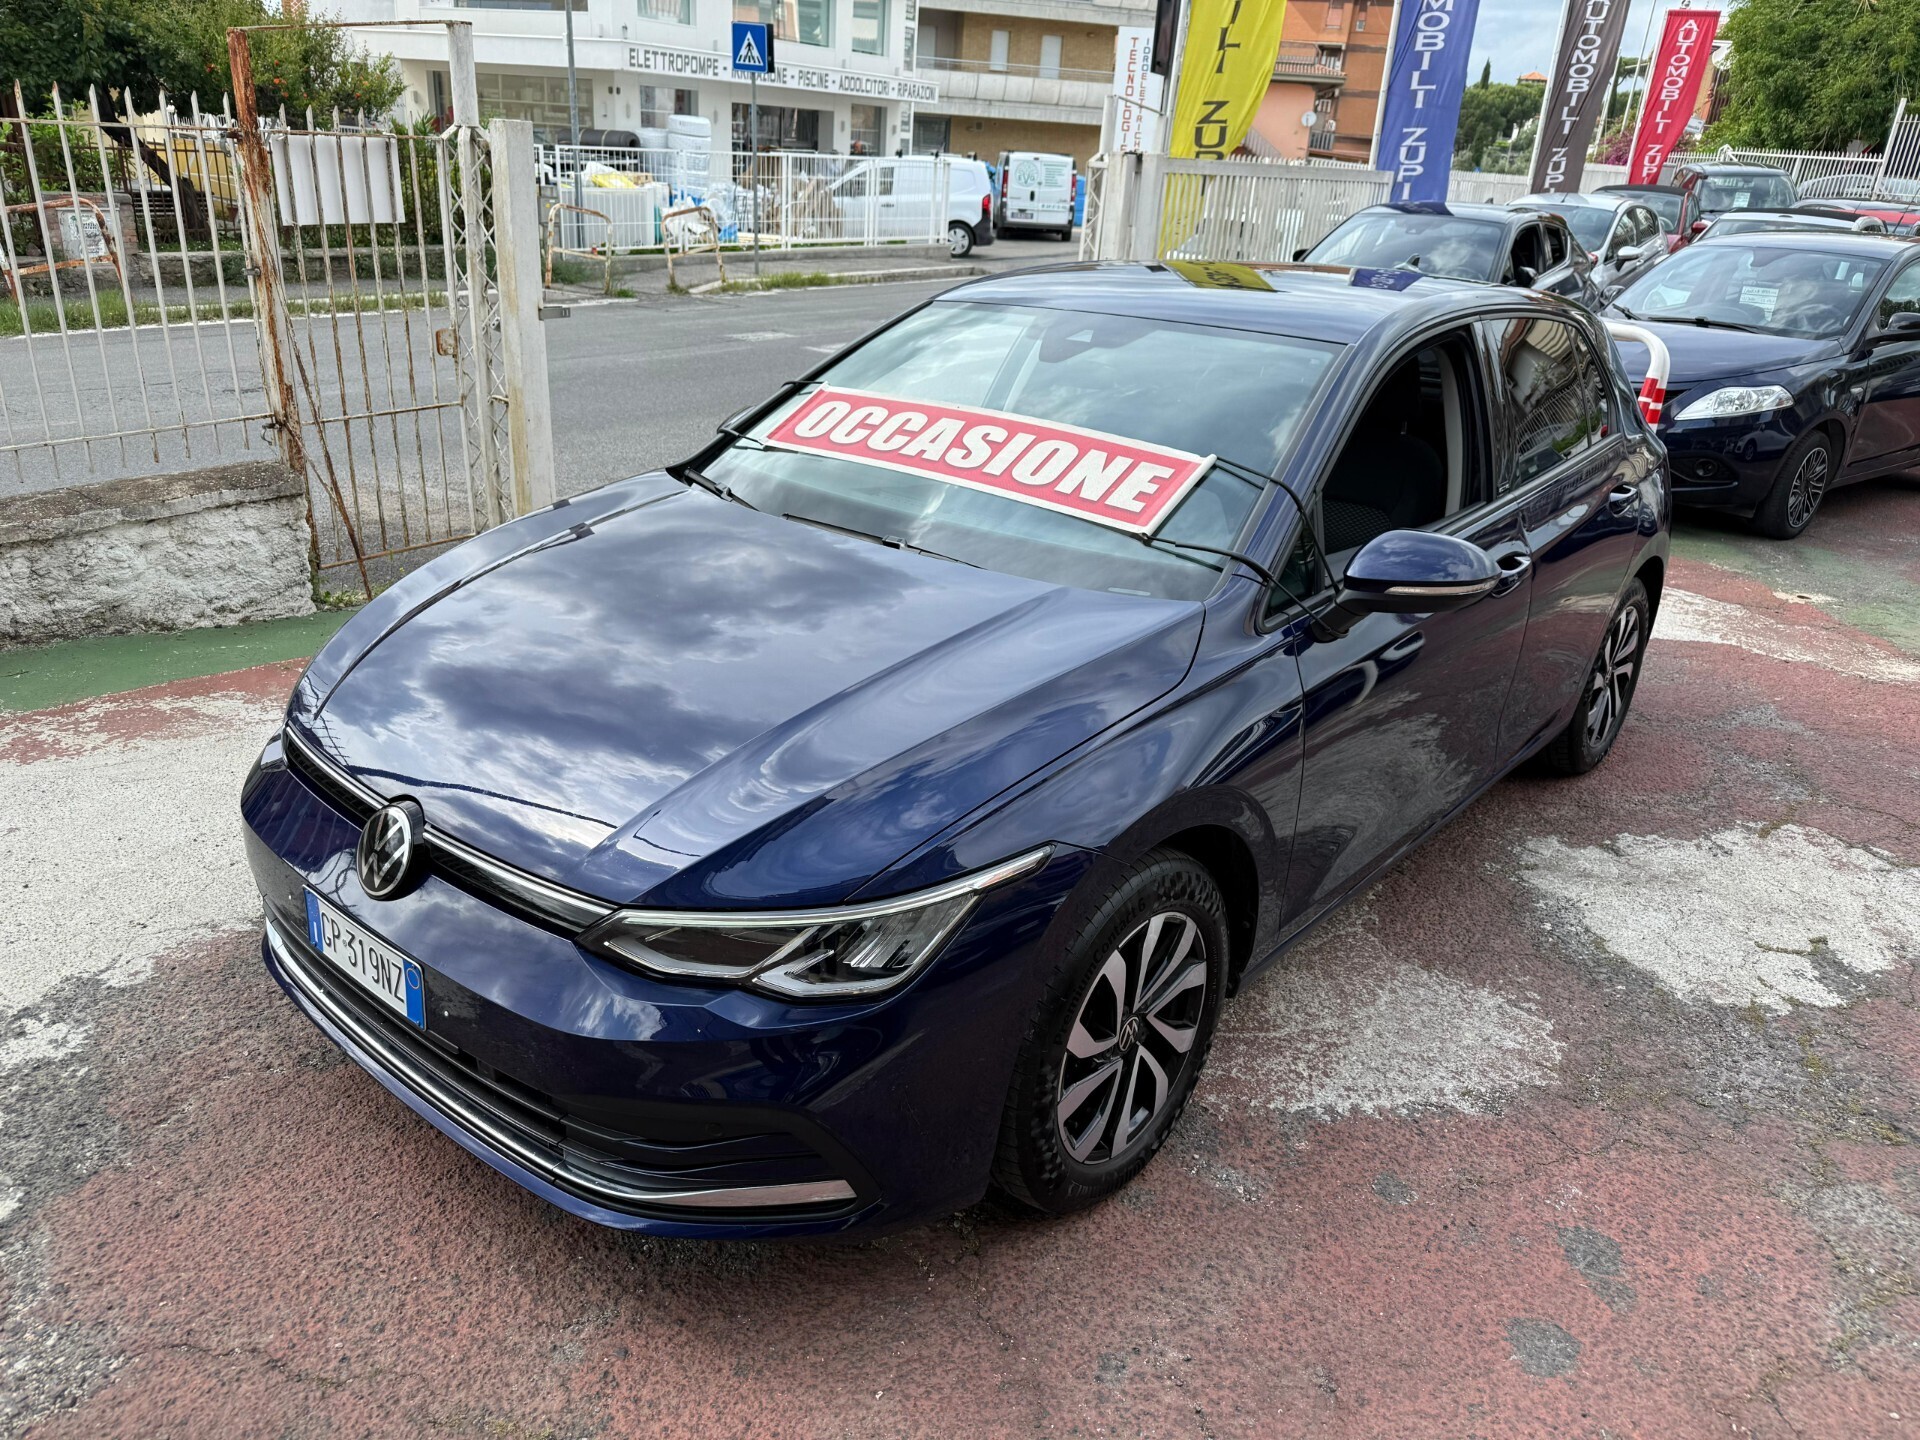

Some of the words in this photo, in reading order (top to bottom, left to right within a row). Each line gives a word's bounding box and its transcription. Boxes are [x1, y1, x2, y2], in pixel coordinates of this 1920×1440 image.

[628, 47, 719, 77] ELETTROPOMPE
[798, 69, 829, 89] PISCINE
[838, 74, 890, 97] ADDOLCITORI
[896, 81, 937, 101] RIPARAZIONI
[1655, 19, 1699, 134] AUTOMOBILI
[1396, 127, 1428, 200] ZUPI
[794, 400, 1175, 513] OCCASIONE
